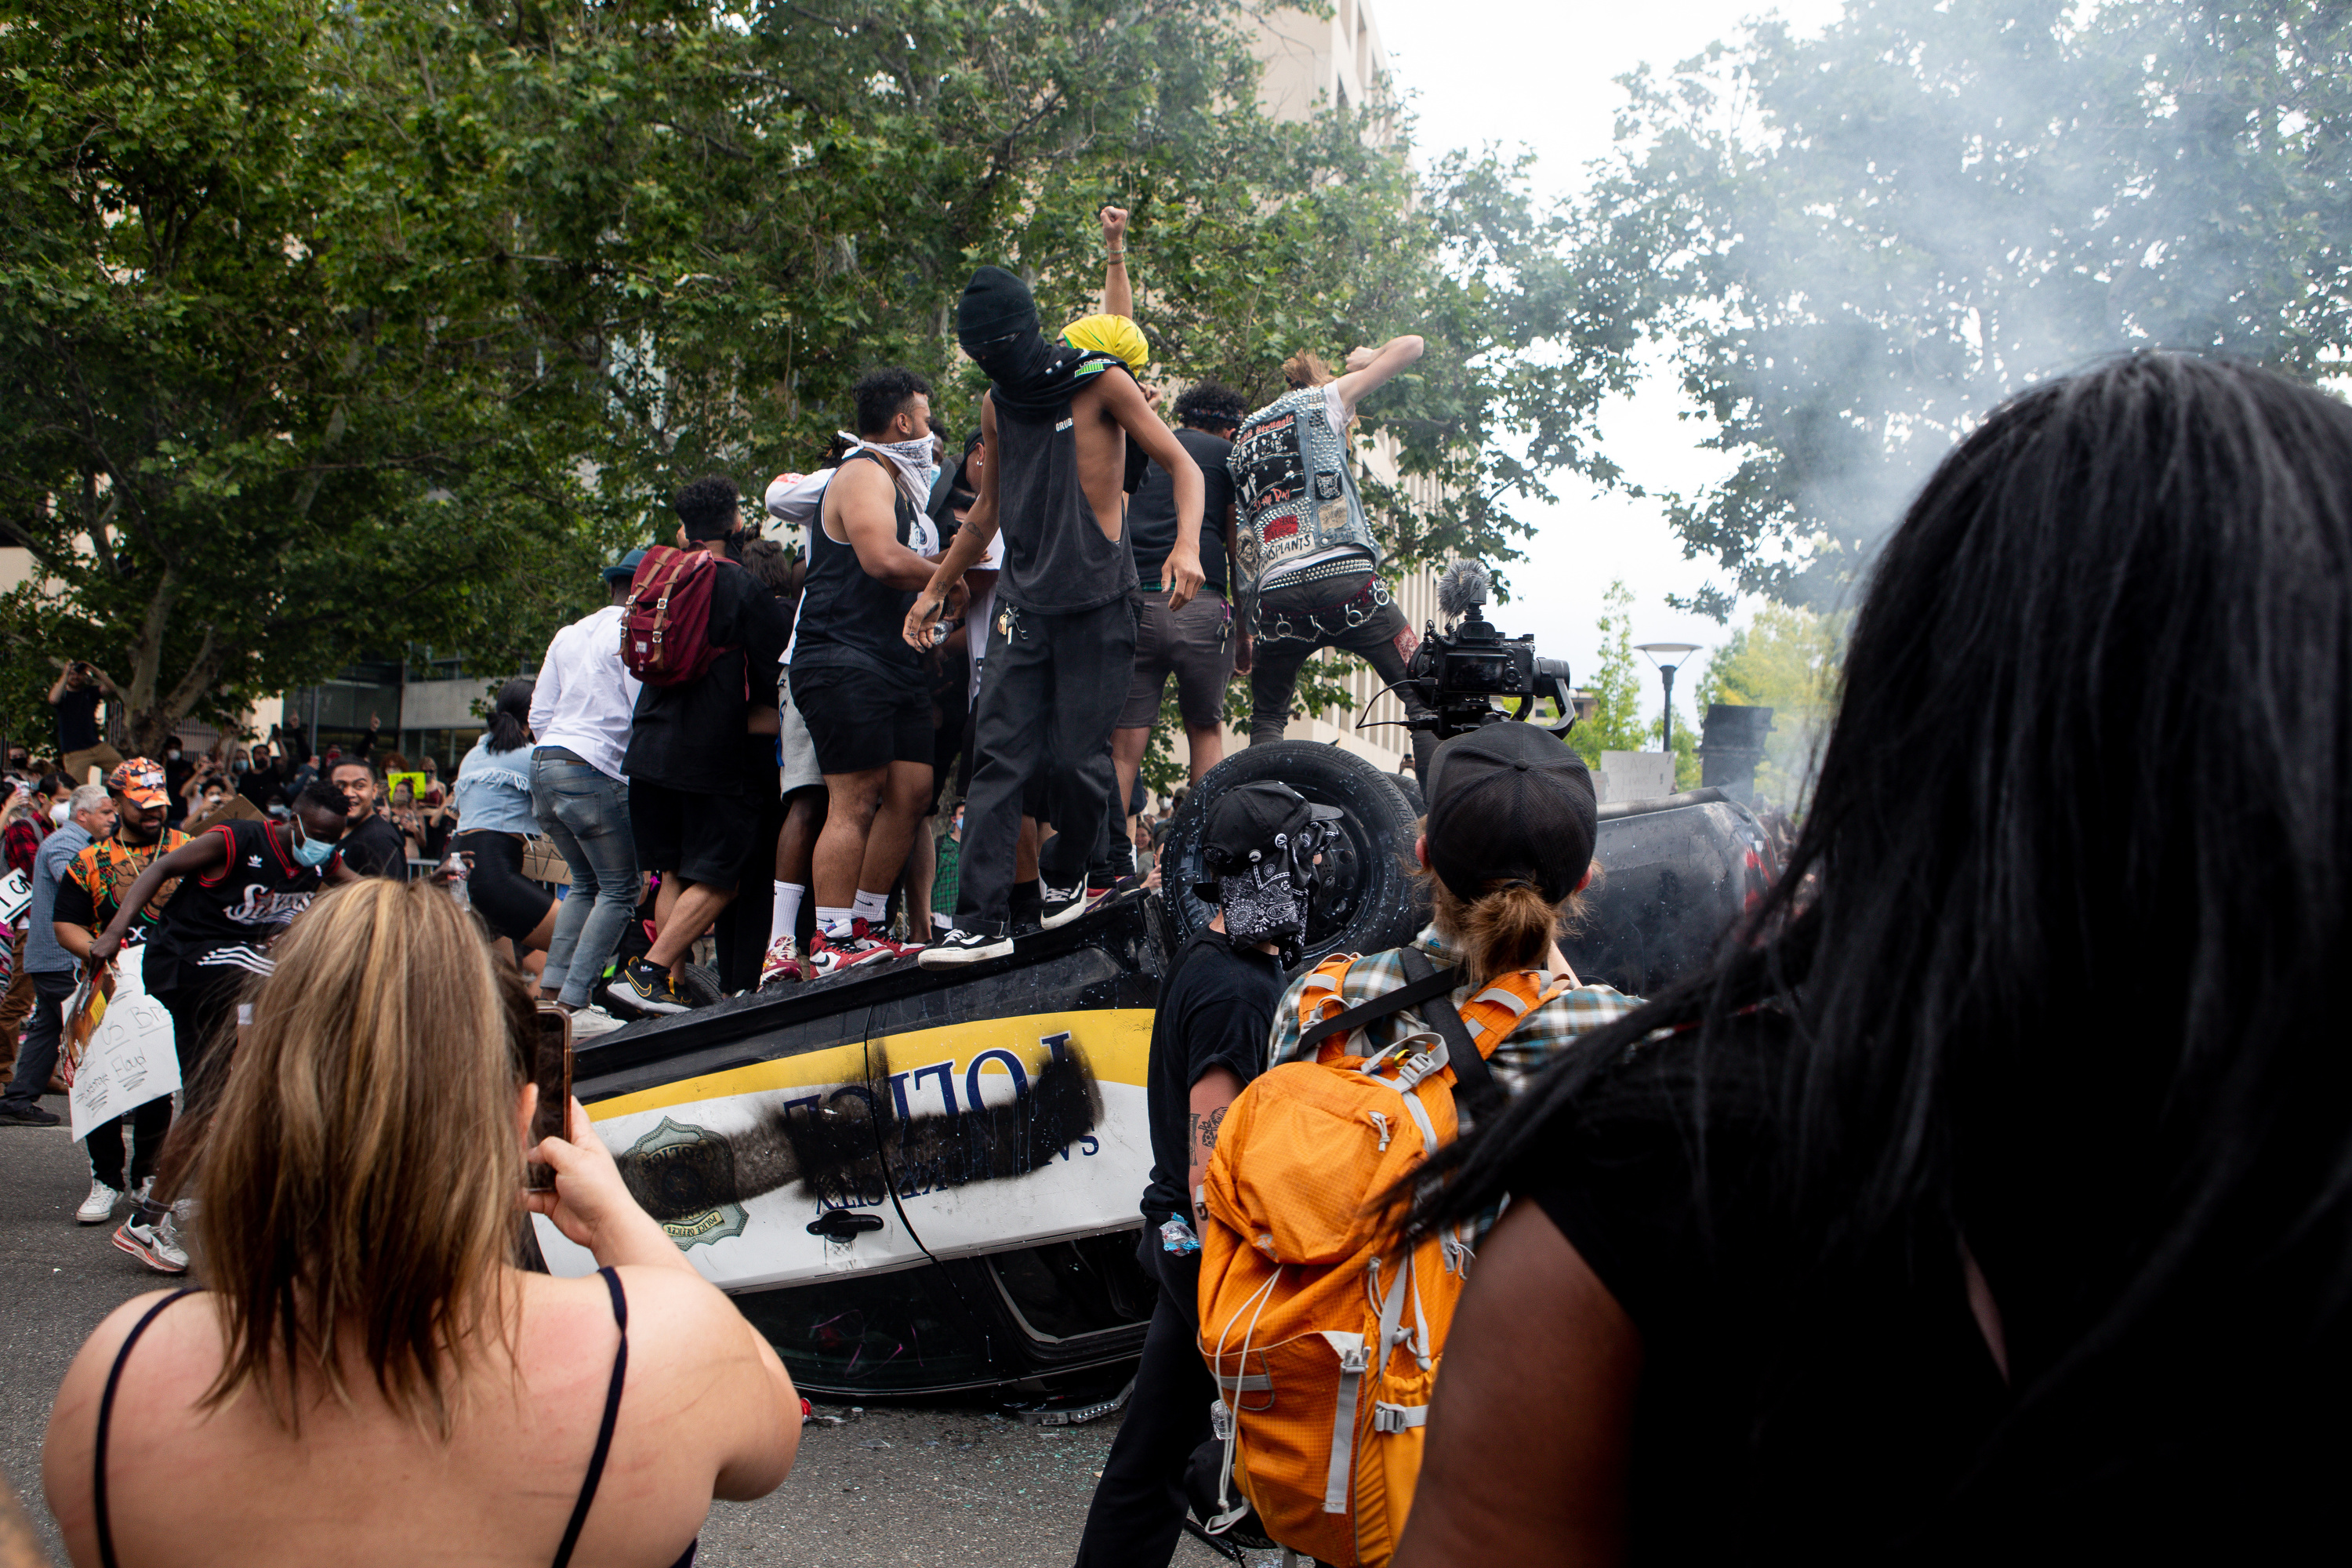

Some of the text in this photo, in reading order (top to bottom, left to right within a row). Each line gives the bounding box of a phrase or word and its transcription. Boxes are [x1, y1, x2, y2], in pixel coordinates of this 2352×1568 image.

[1055, 417, 1073, 432] GRUB
[641, 1147, 706, 1175] POLICE
[666, 1215, 717, 1238] POLICE OFFICER
